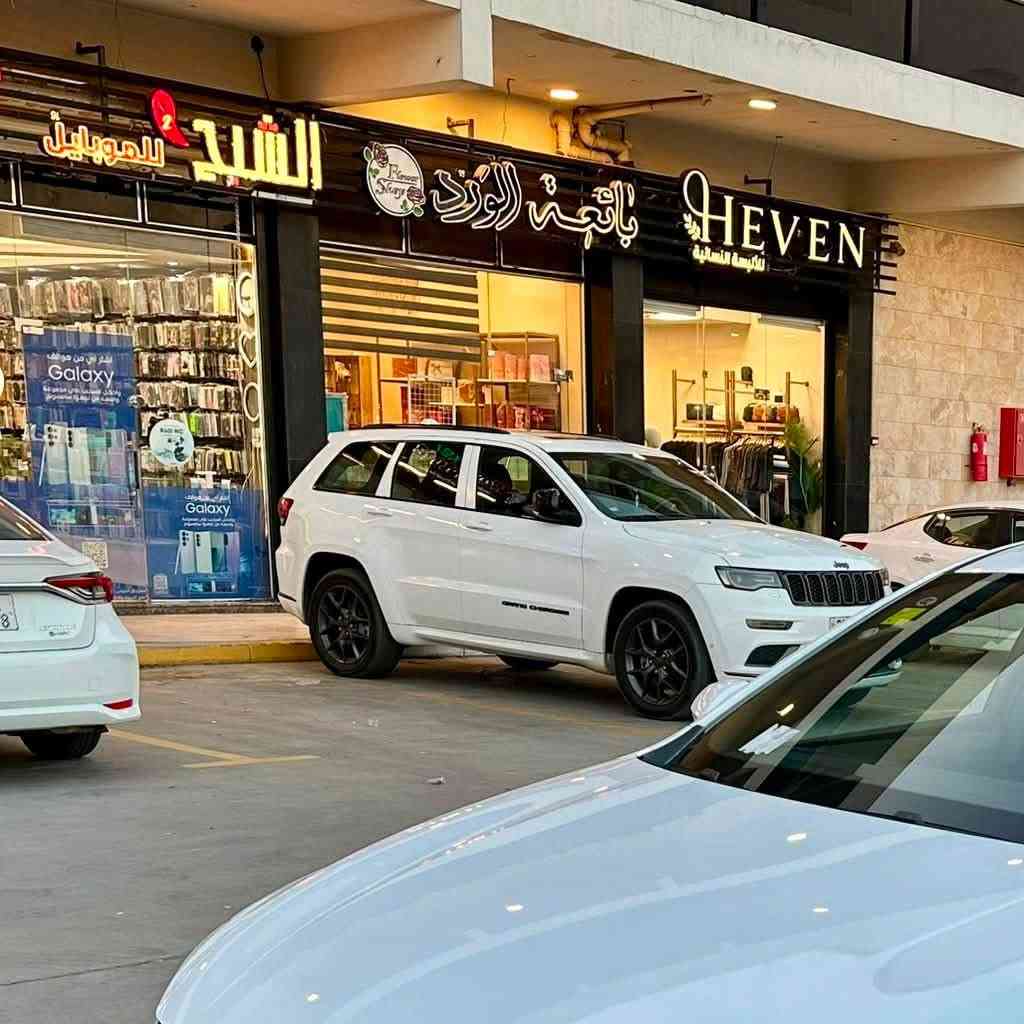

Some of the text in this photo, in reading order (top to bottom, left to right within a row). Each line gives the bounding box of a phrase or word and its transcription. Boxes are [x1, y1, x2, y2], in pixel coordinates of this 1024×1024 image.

[161, 115, 173, 130] 2
[526, 173, 639, 250] بائعة
[683, 170, 866, 269] HEVEN
[48, 364, 114, 388] Galaxy
[184, 501, 231, 518] Galaxy
